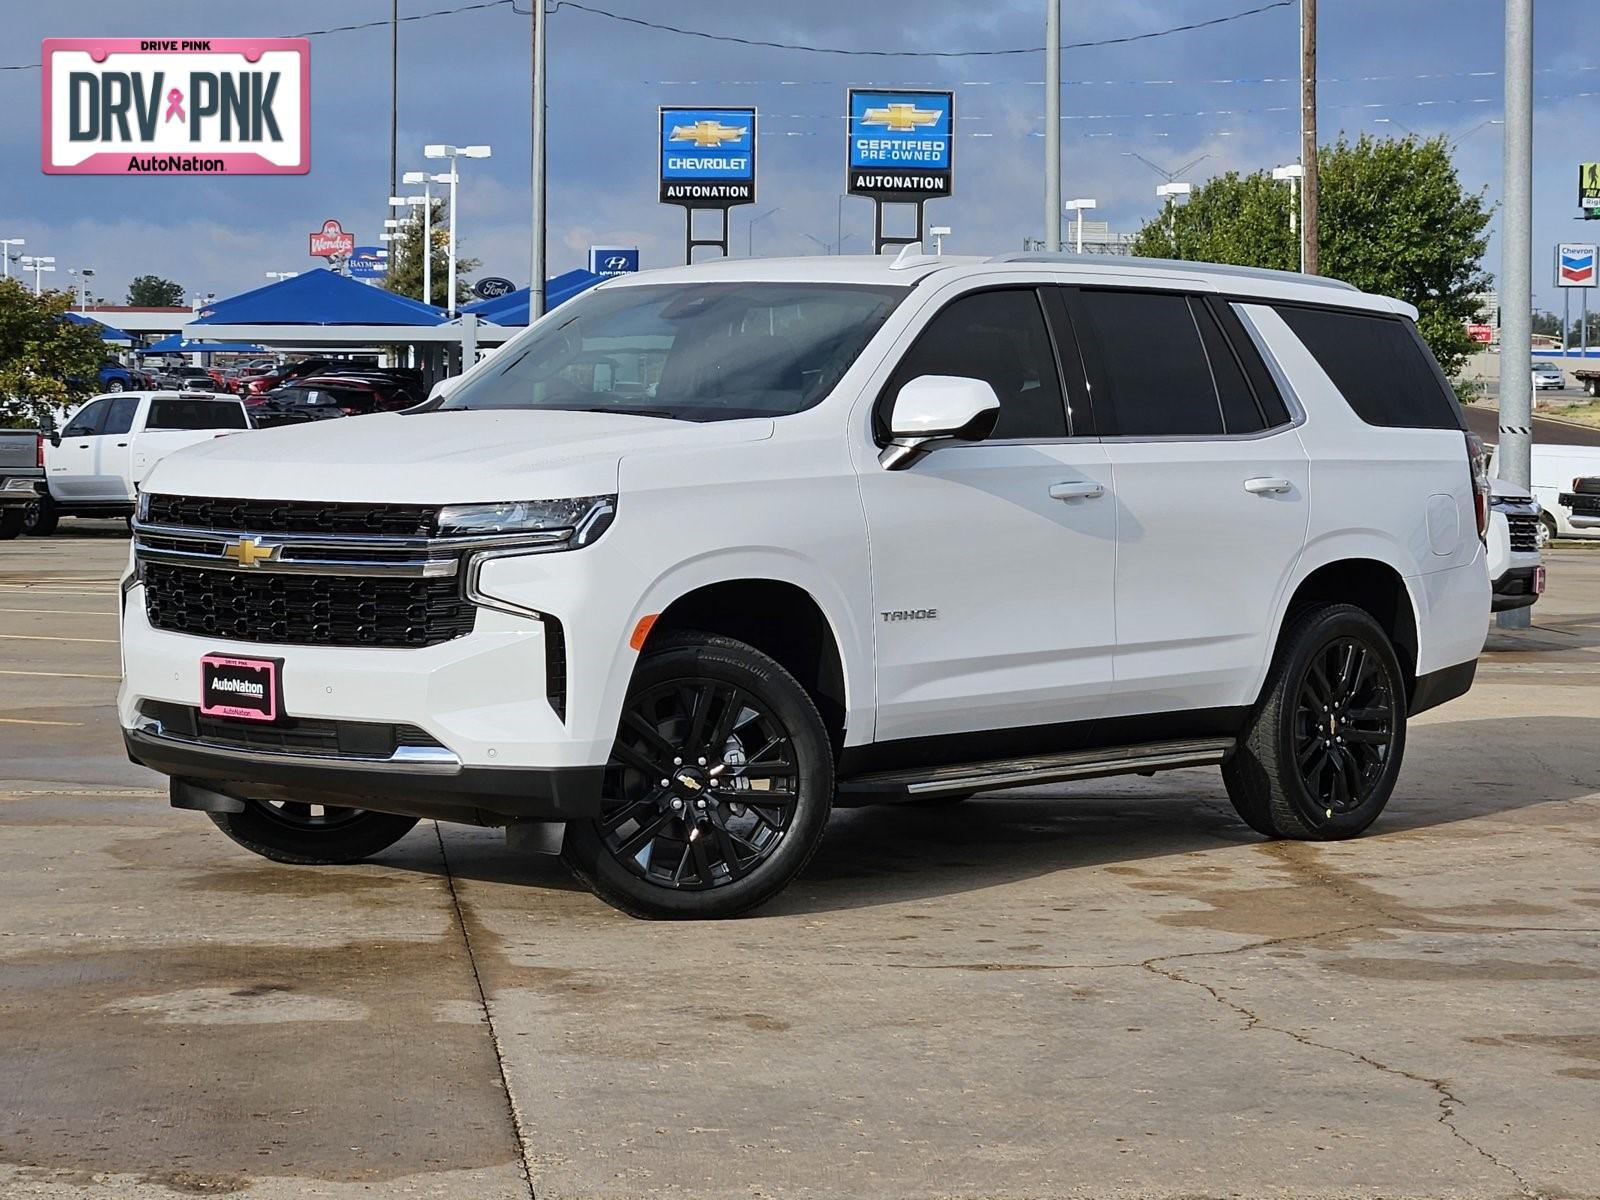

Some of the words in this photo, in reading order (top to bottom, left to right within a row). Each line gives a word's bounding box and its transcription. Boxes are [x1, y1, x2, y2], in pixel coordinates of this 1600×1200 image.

[856, 139, 945, 151] CERTIFIED
[860, 149, 941, 161] PRE-OWNED
[668, 157, 748, 170] CHEVROLET
[856, 175, 944, 189] AUTONATION
[667, 185, 749, 198] AUTONATION
[311, 236, 352, 253] Wendy's
[1562, 247, 1594, 255] Chevron
[483, 281, 508, 296] Ford
[880, 608, 937, 622] TAHOE
[211, 677, 264, 694] AutoNation
